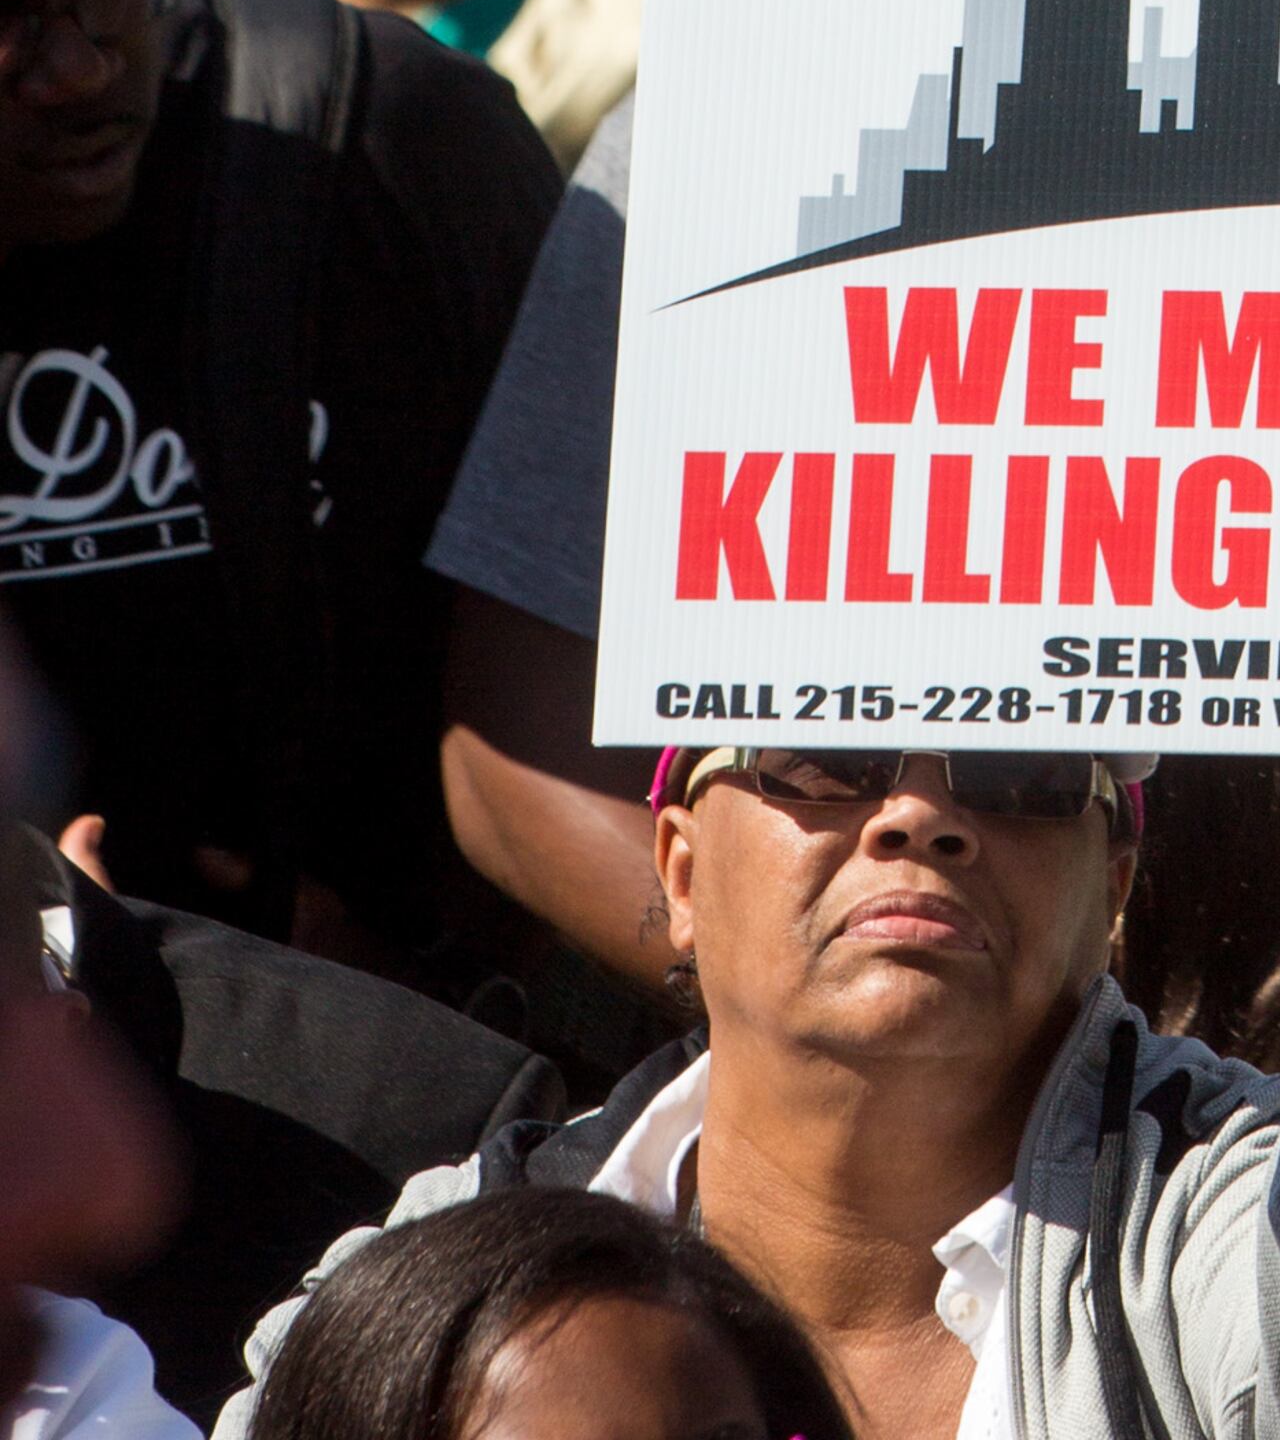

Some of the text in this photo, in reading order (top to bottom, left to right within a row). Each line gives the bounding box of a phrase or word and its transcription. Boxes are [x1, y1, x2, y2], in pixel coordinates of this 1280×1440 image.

[843, 286, 1108, 427] WE
[675, 451, 1273, 611] KILLING
[655, 682, 781, 720] CALL
[794, 685, 1183, 725] 215-228-1718
[1201, 697, 1262, 726] OR
